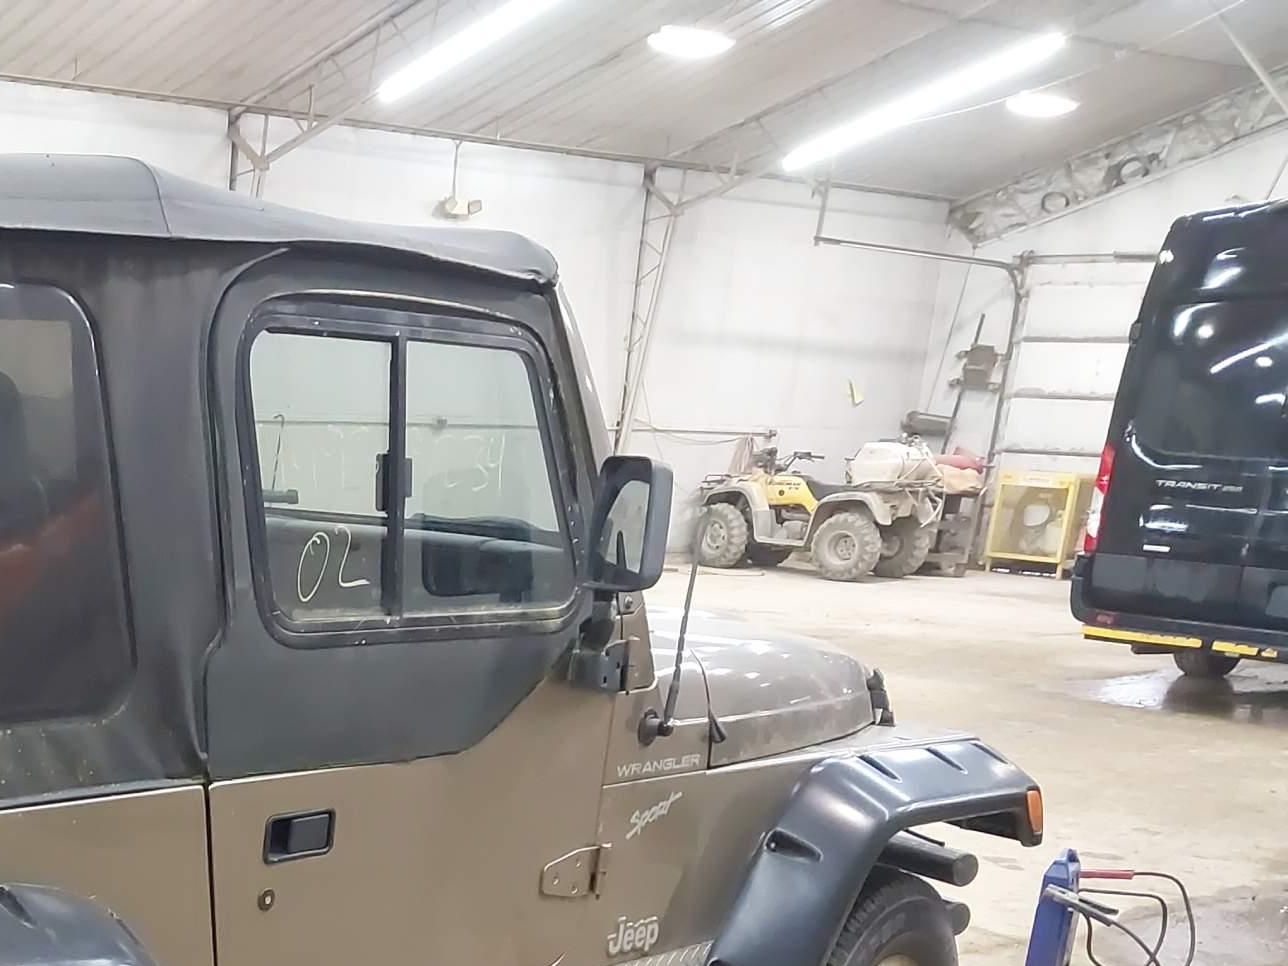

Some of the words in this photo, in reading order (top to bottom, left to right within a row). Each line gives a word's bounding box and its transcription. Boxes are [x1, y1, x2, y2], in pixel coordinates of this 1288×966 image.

[1155, 479, 1223, 491] TRANSIT
[616, 753, 701, 778] WRANGLER
[624, 791, 683, 840] Sport
[606, 916, 660, 957] Jeep
